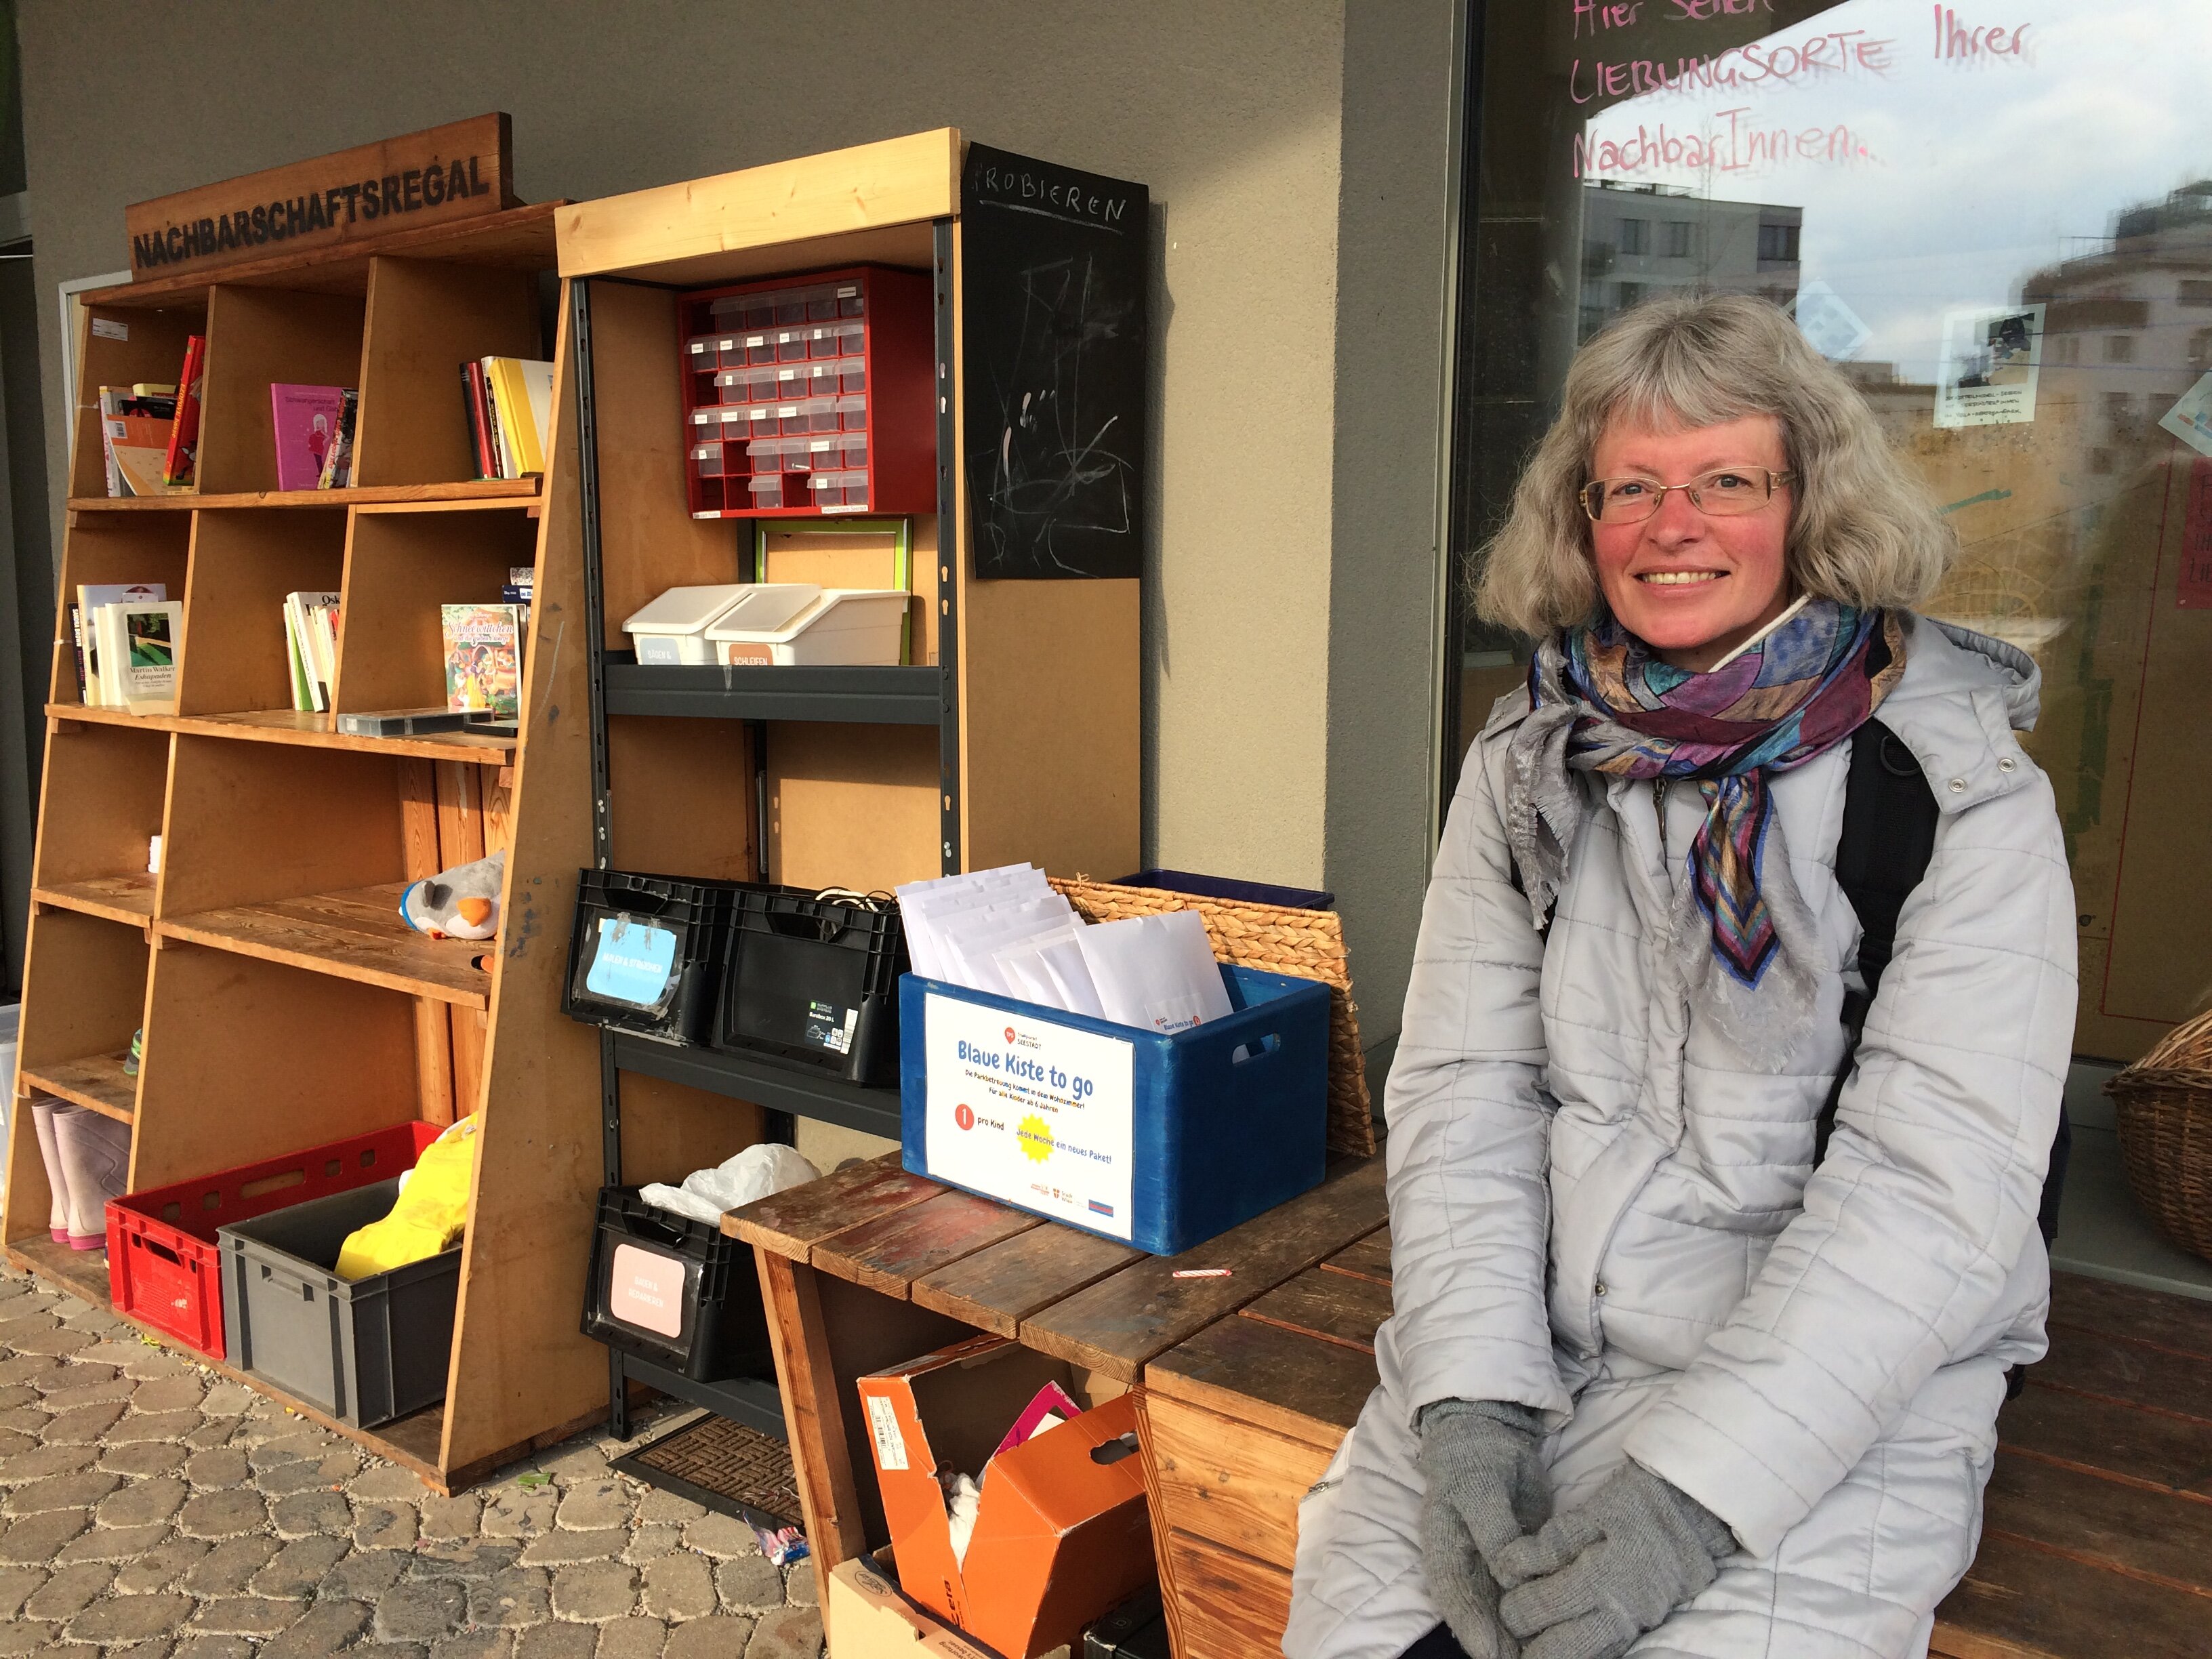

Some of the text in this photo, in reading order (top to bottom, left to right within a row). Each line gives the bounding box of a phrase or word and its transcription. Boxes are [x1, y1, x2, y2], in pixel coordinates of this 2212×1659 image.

[1934, 4, 2032, 60] Ihrer
[133, 155, 490, 270] NACHBARSCHAFTSREGAL
[734, 657, 768, 665] SCHLEIFEN
[1017, 1038, 1042, 1050] SEESTADT
[958, 1040, 1093, 1101] Blaue Kiste to go
[965, 1069, 973, 1078] Die
[989, 1086, 998, 1095] Für
[1009, 1093, 1025, 1103] Kinder
[1040, 1102, 1059, 1113] Jahren
[962, 1107, 967, 1126] 1
[977, 1116, 1004, 1130] pro Kind
[1017, 1128, 1111, 1164] Jede Woche ein neues Paket!
